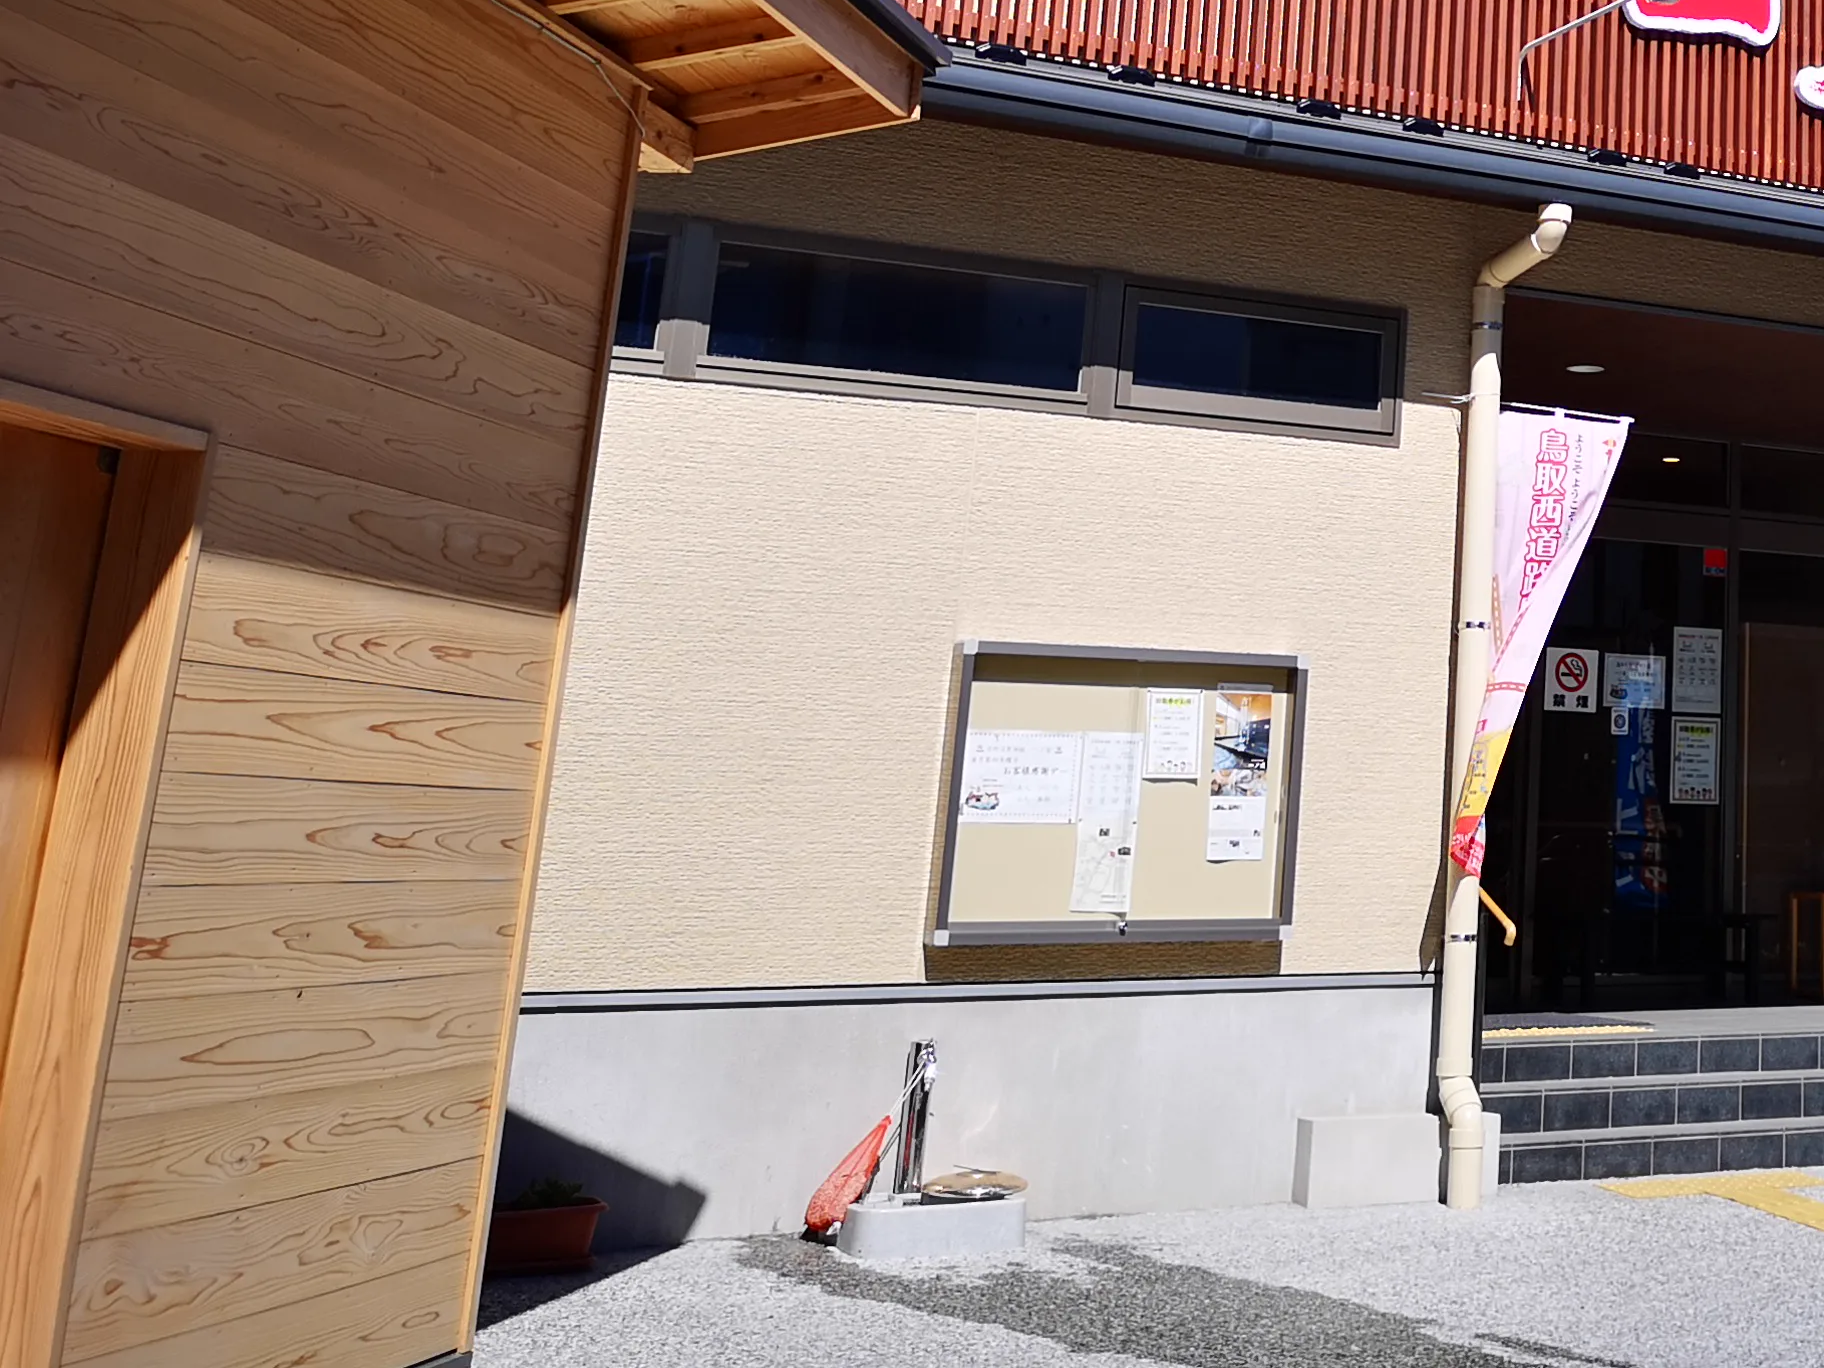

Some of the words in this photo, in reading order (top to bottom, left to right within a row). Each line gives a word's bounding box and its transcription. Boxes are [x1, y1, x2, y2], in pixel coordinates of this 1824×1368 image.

[1517, 428, 1569, 613] 鳥取西道路
[1552, 693, 1589, 709] 禁煙
